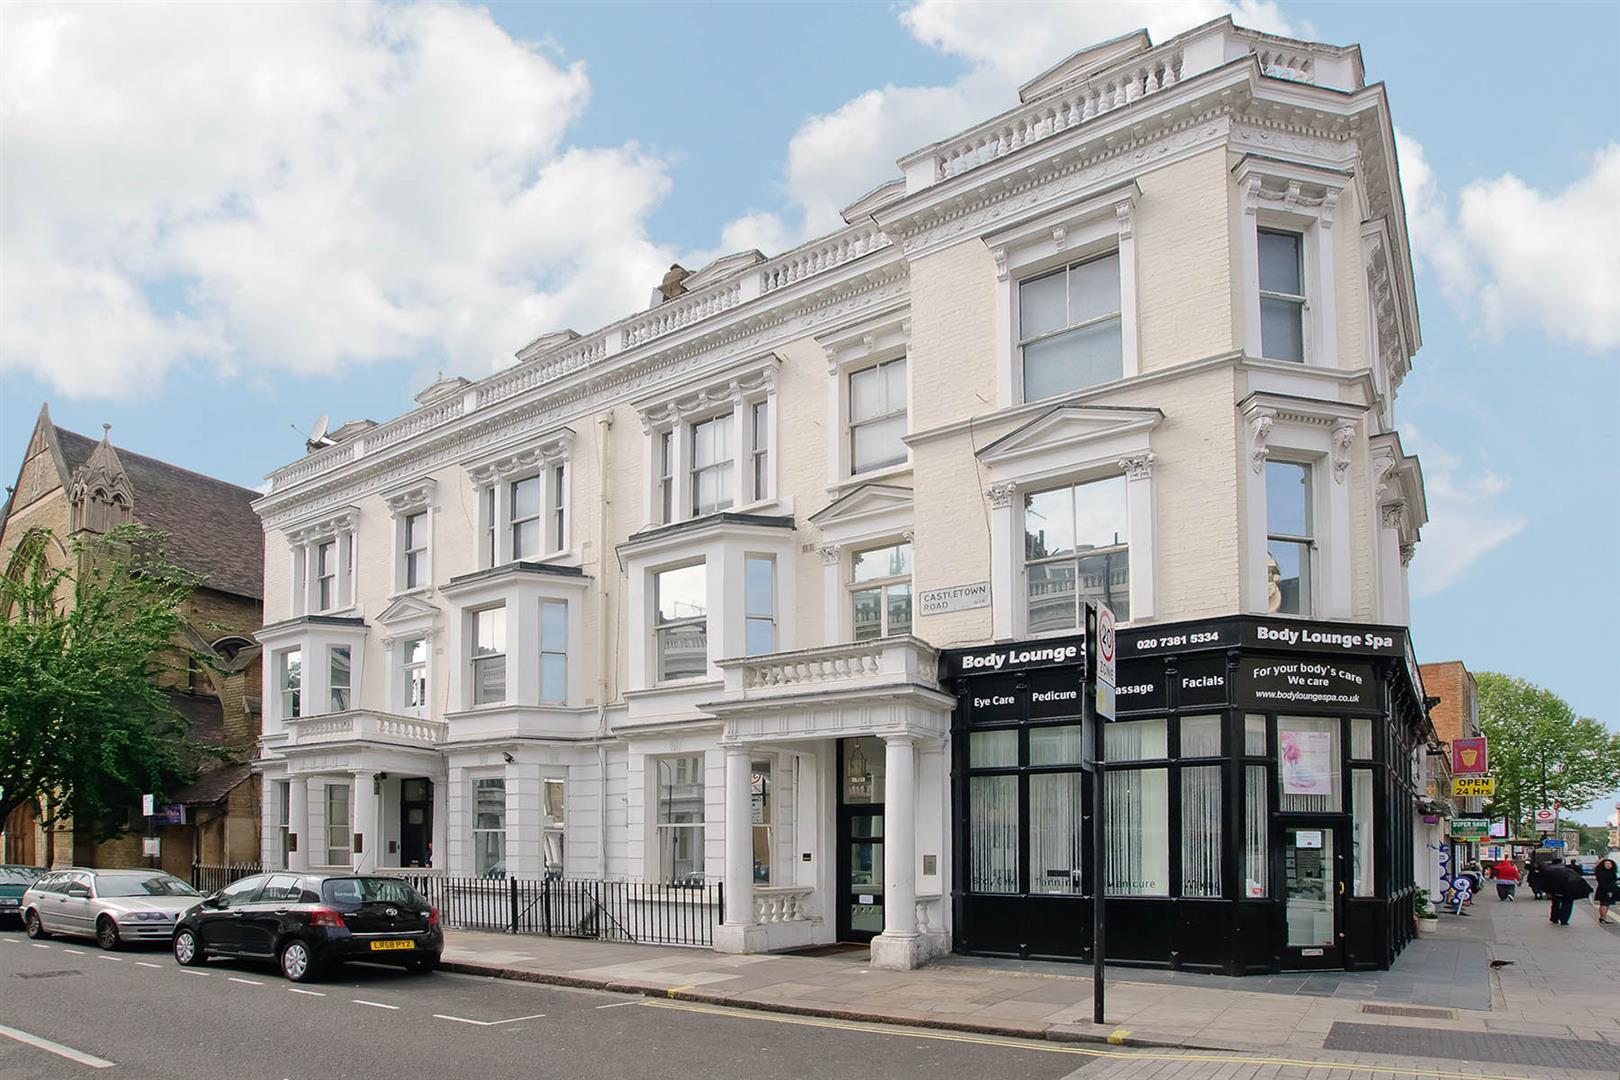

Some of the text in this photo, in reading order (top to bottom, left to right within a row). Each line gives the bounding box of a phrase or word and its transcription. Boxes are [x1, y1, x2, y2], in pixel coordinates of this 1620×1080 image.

[924, 586, 986, 602] CASTLETOWN
[923, 601, 949, 612] ROAD
[1102, 623, 1112, 649] 20
[1136, 631, 1219, 650] 020 7381 5334
[1257, 626, 1393, 650] Body Lounge Spa
[962, 652, 1006, 669] Body
[1009, 645, 1077, 664] Lounge
[1253, 663, 1362, 685] For your body's care
[1287, 675, 1329, 686] We care
[1182, 675, 1224, 689] Facials
[1115, 683, 1154, 695] assage
[974, 695, 1015, 708] Eye Care
[1032, 690, 1077, 702] Pedicure
[1255, 690, 1360, 703] www.bodyloungespa.co.uk
[1459, 779, 1489, 787] OPEN
